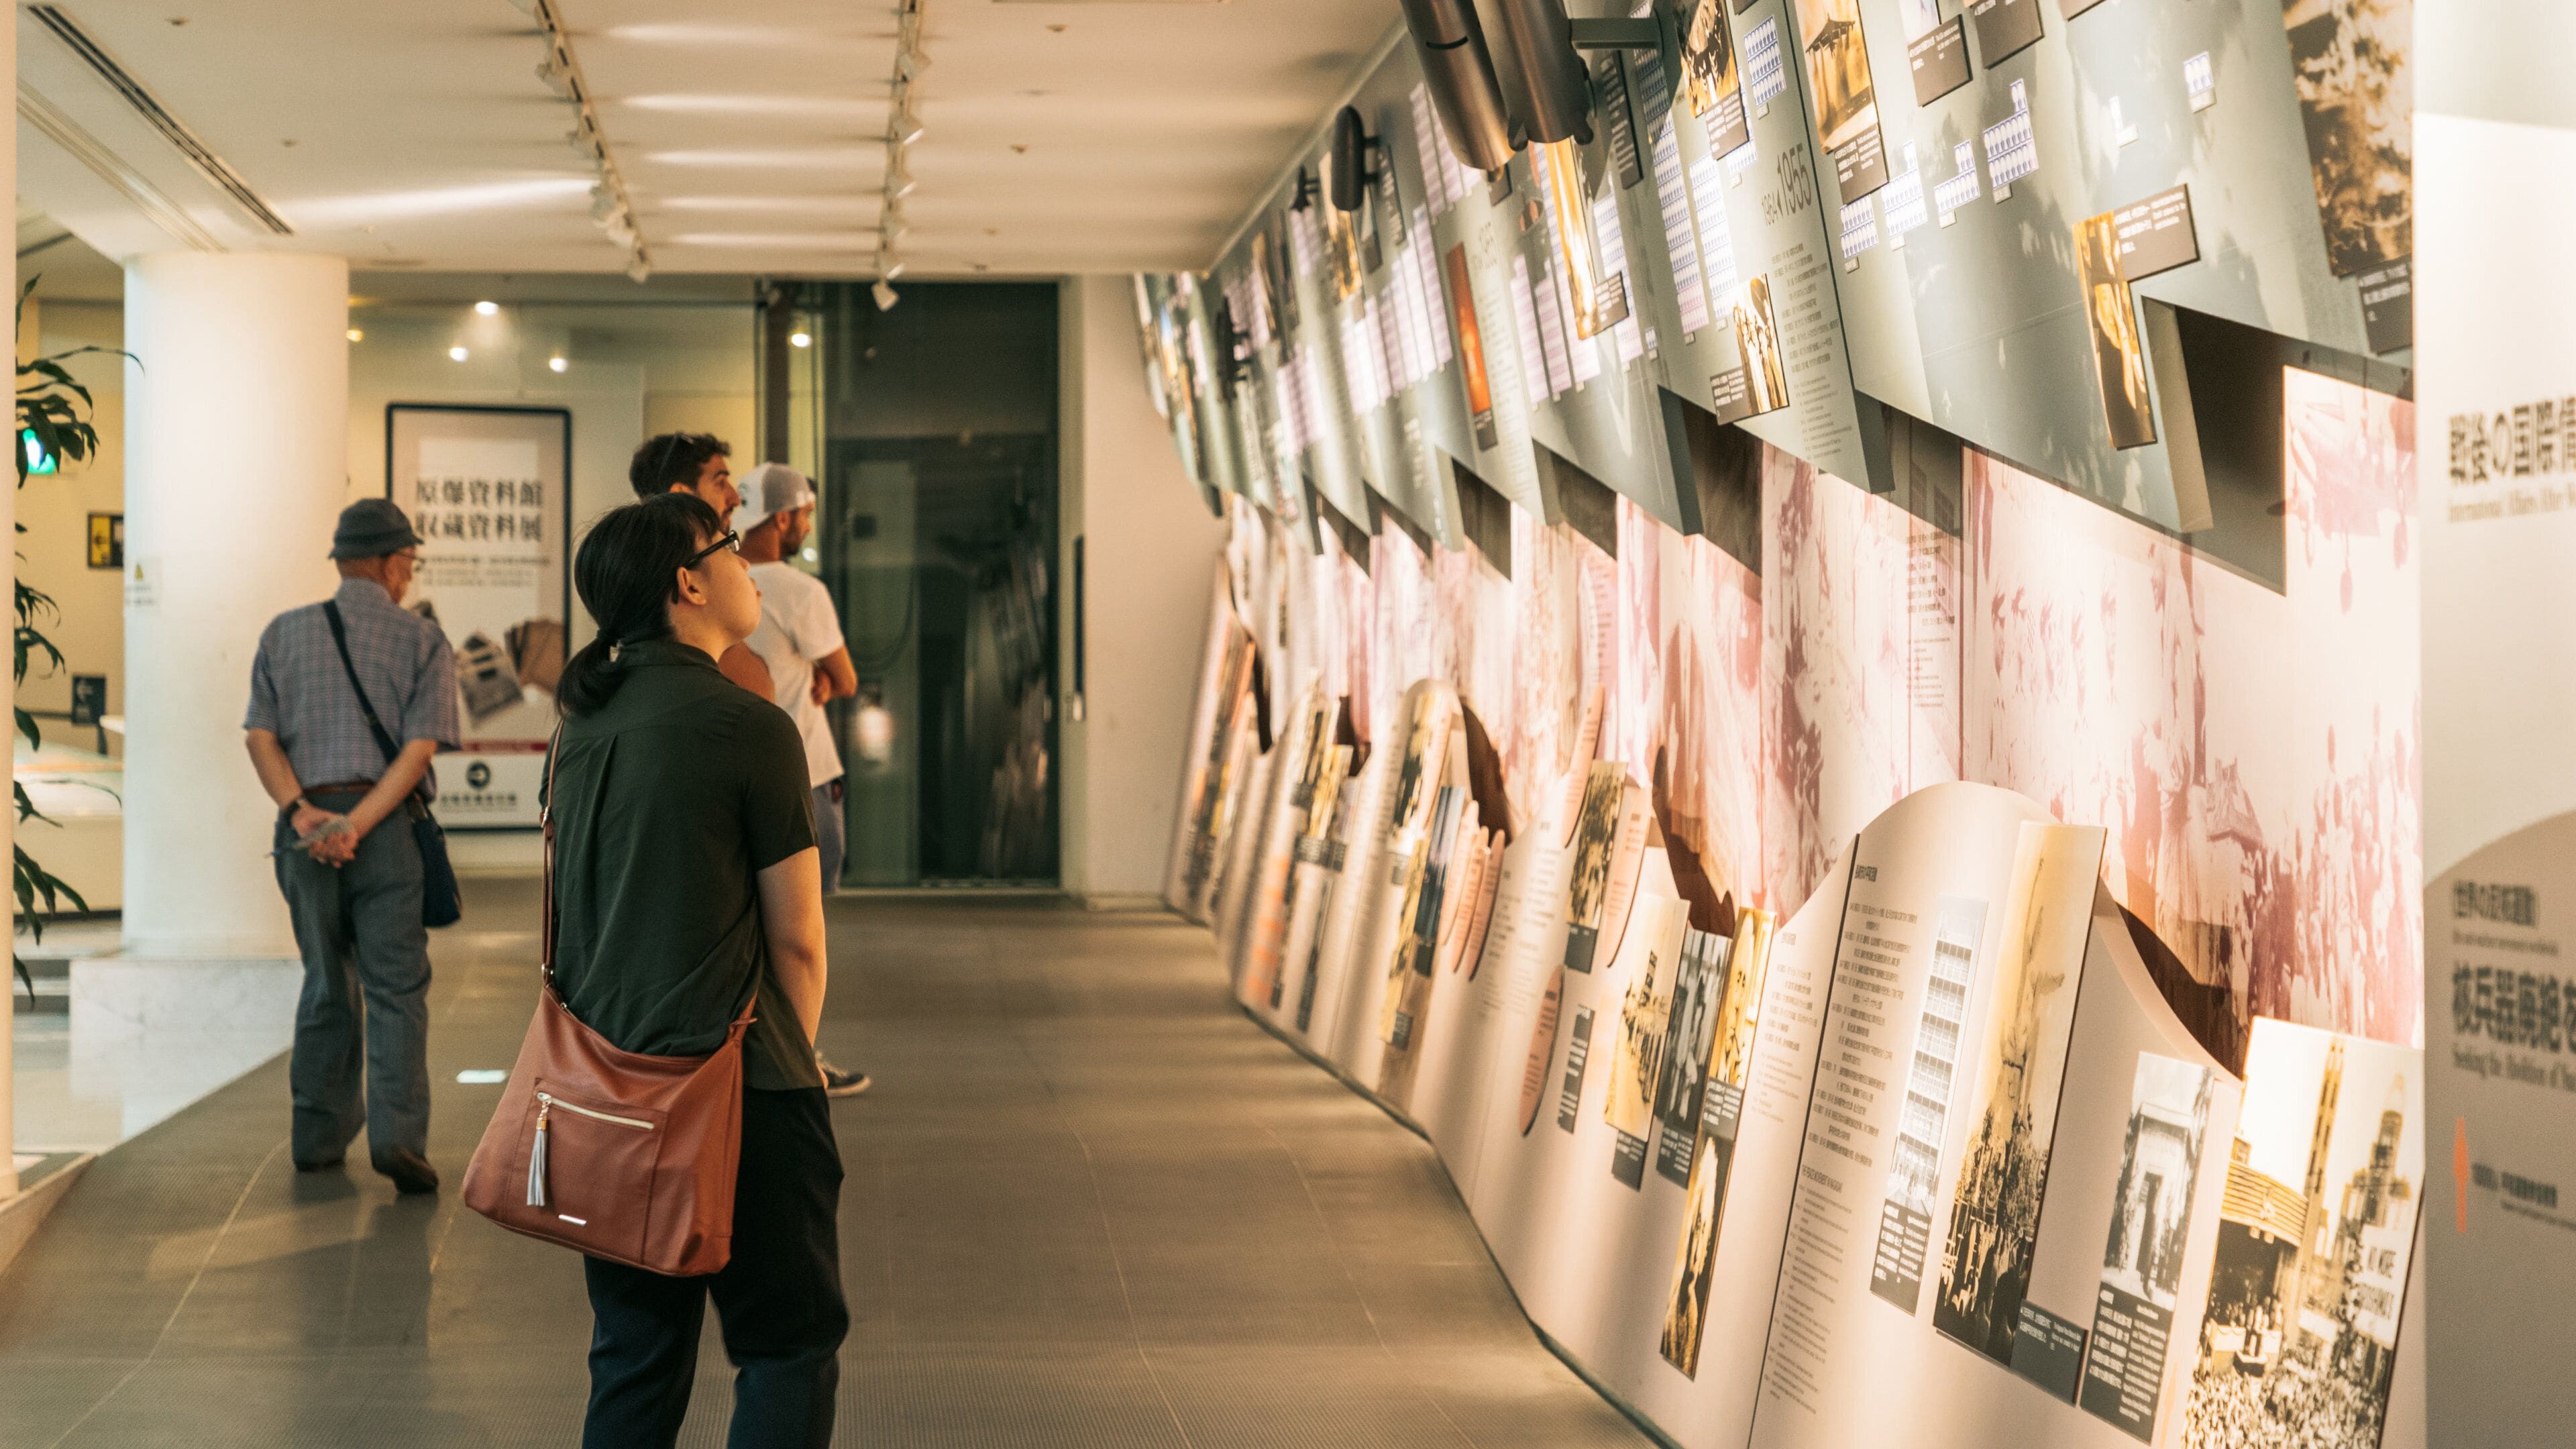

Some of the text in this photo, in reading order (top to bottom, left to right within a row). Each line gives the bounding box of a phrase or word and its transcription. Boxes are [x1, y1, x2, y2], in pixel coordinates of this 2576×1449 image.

[1778, 142, 1811, 215] 1955
[417, 479, 542, 506] 原爆資料館
